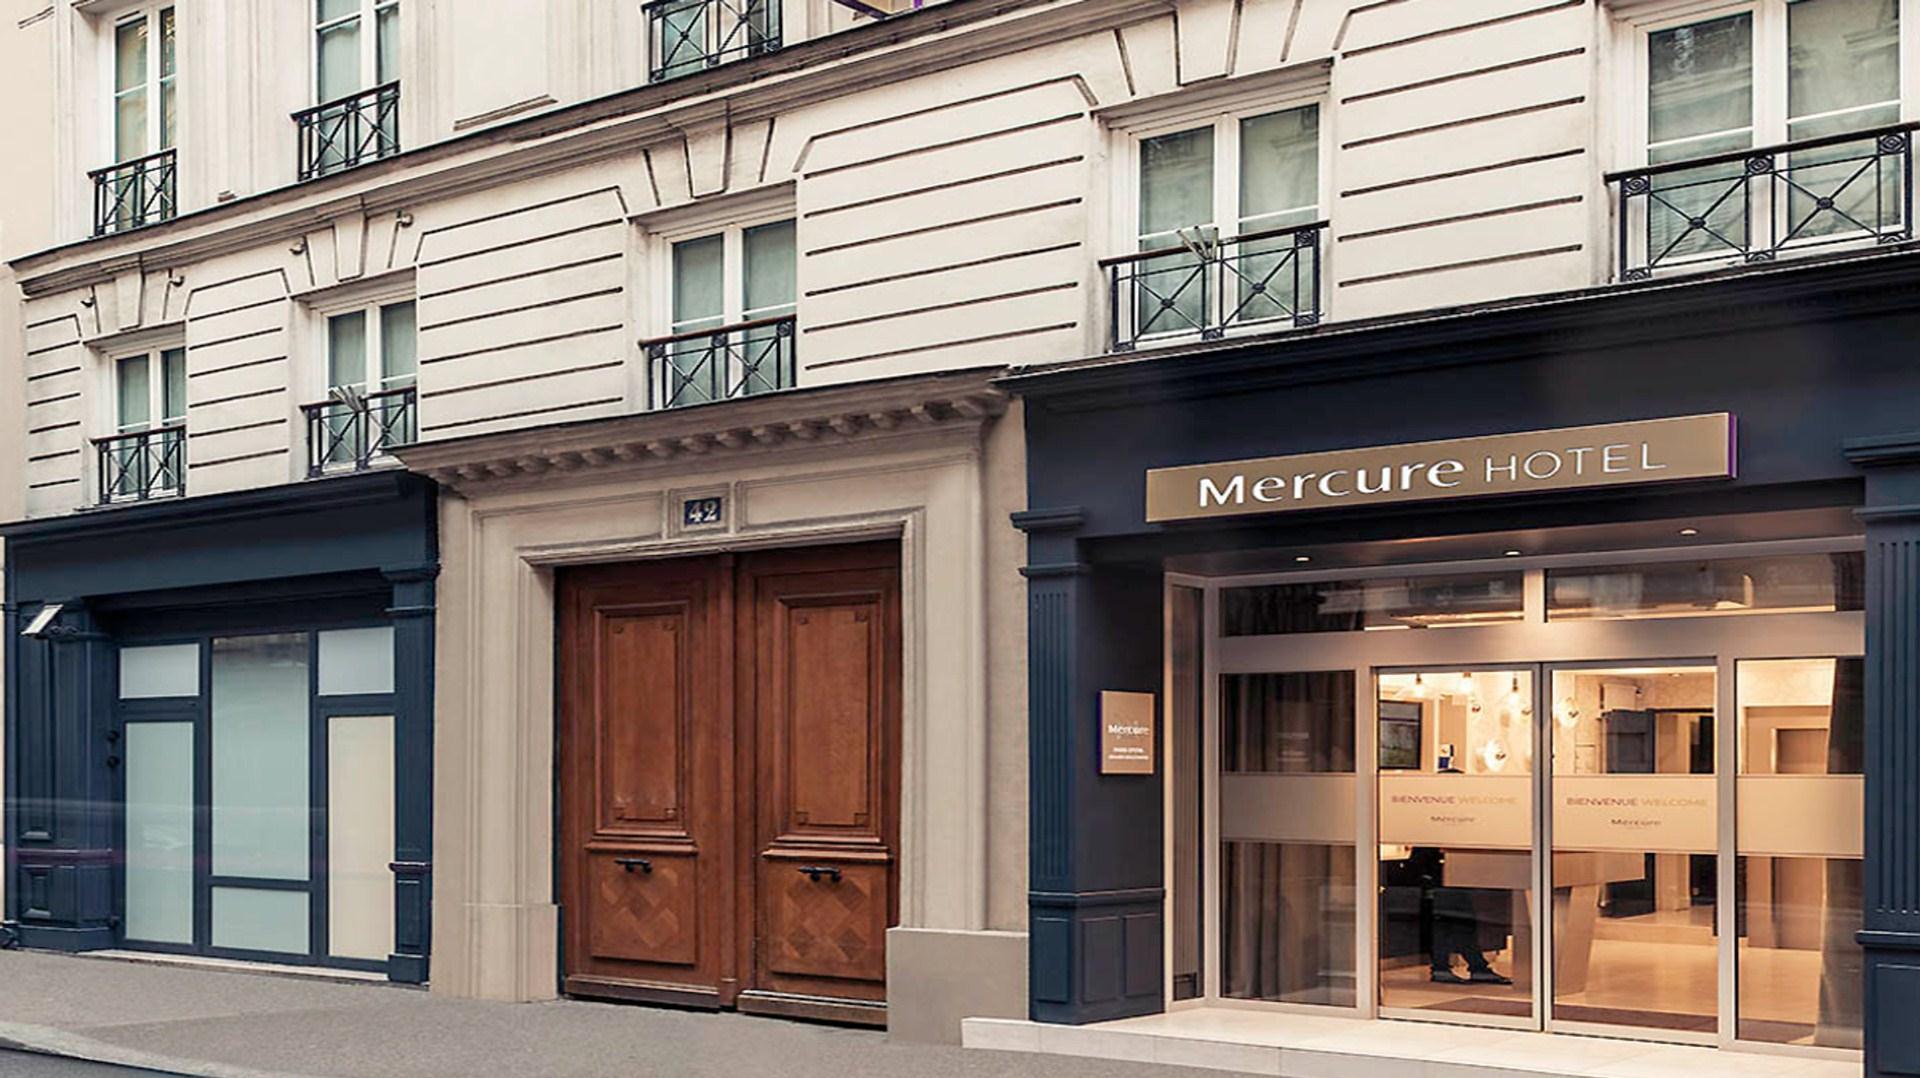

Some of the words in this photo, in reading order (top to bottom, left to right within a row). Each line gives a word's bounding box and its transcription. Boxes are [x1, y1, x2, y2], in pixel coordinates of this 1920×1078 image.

[1198, 457, 1466, 507] Mercure
[1484, 442, 1667, 482] HOTEL
[688, 500, 717, 523] 42
[1391, 795, 1455, 804] BIENVENUE
[1458, 796, 1517, 805] WELCOME
[1566, 797, 1638, 806] BIENVENUE
[1641, 798, 1707, 807] WELCOME
